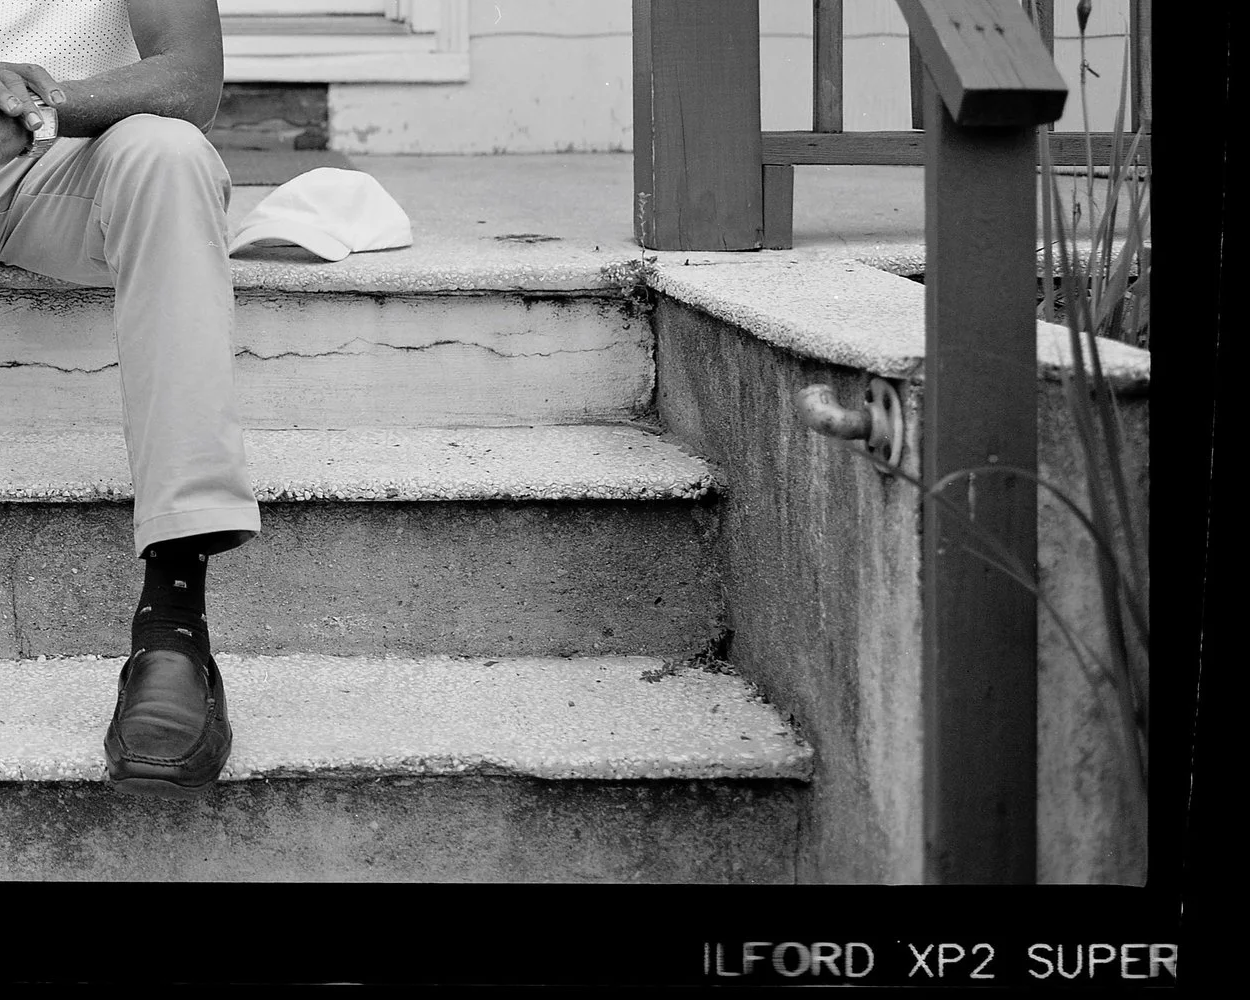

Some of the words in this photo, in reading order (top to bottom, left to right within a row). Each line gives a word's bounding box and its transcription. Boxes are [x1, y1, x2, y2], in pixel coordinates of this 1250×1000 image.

[703, 941, 875, 978] ILFORD
[907, 942, 996, 979] XP2
[1027, 943, 1179, 980] SUPER
